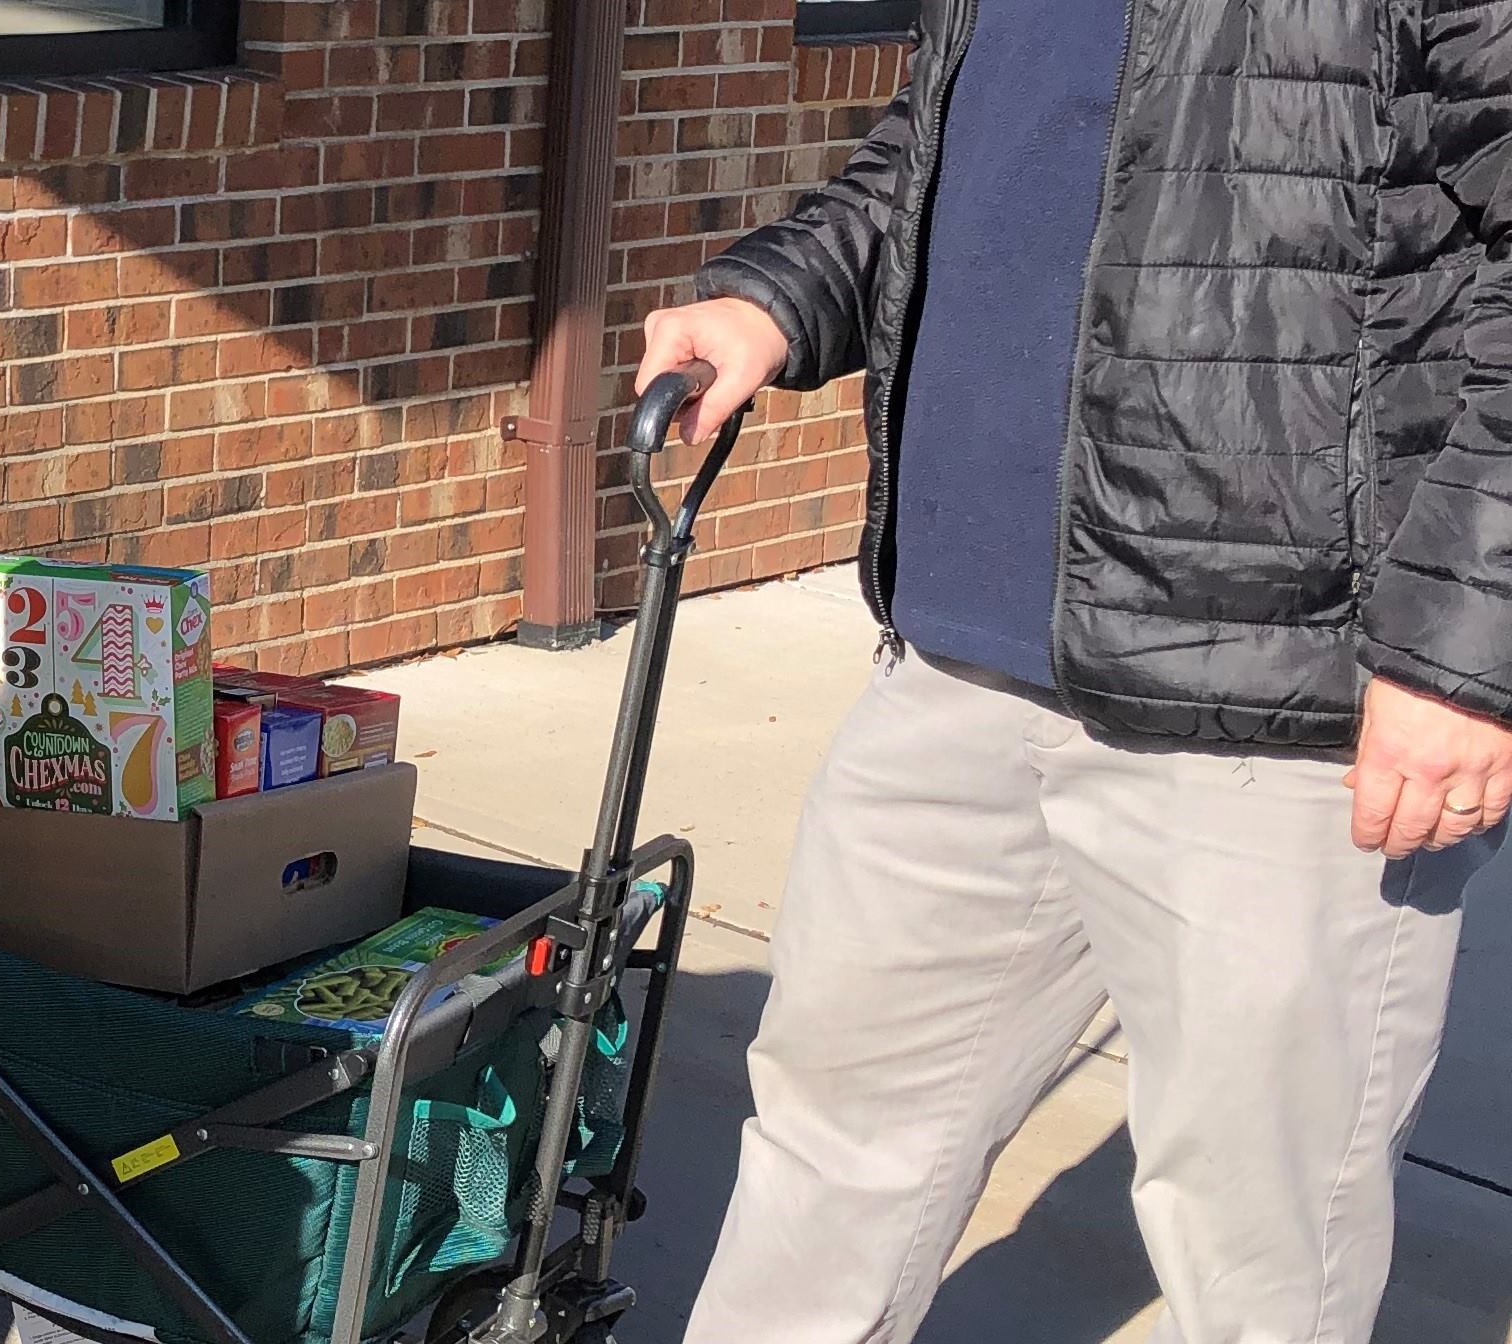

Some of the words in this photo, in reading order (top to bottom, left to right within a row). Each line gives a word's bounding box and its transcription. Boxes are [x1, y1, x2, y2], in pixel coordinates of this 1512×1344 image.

[8, 587, 47, 645] 2
[56, 591, 96, 642] 5
[180, 615, 202, 637] Chex
[2, 645, 41, 689] 3
[72, 603, 142, 701] 4
[24, 731, 89, 756] COUNTDOWN
[110, 712, 167, 816] 7
[10, 745, 106, 789] CHEXMAS
[55, 798, 70, 811] 12
[70, 783, 102, 796] .com
